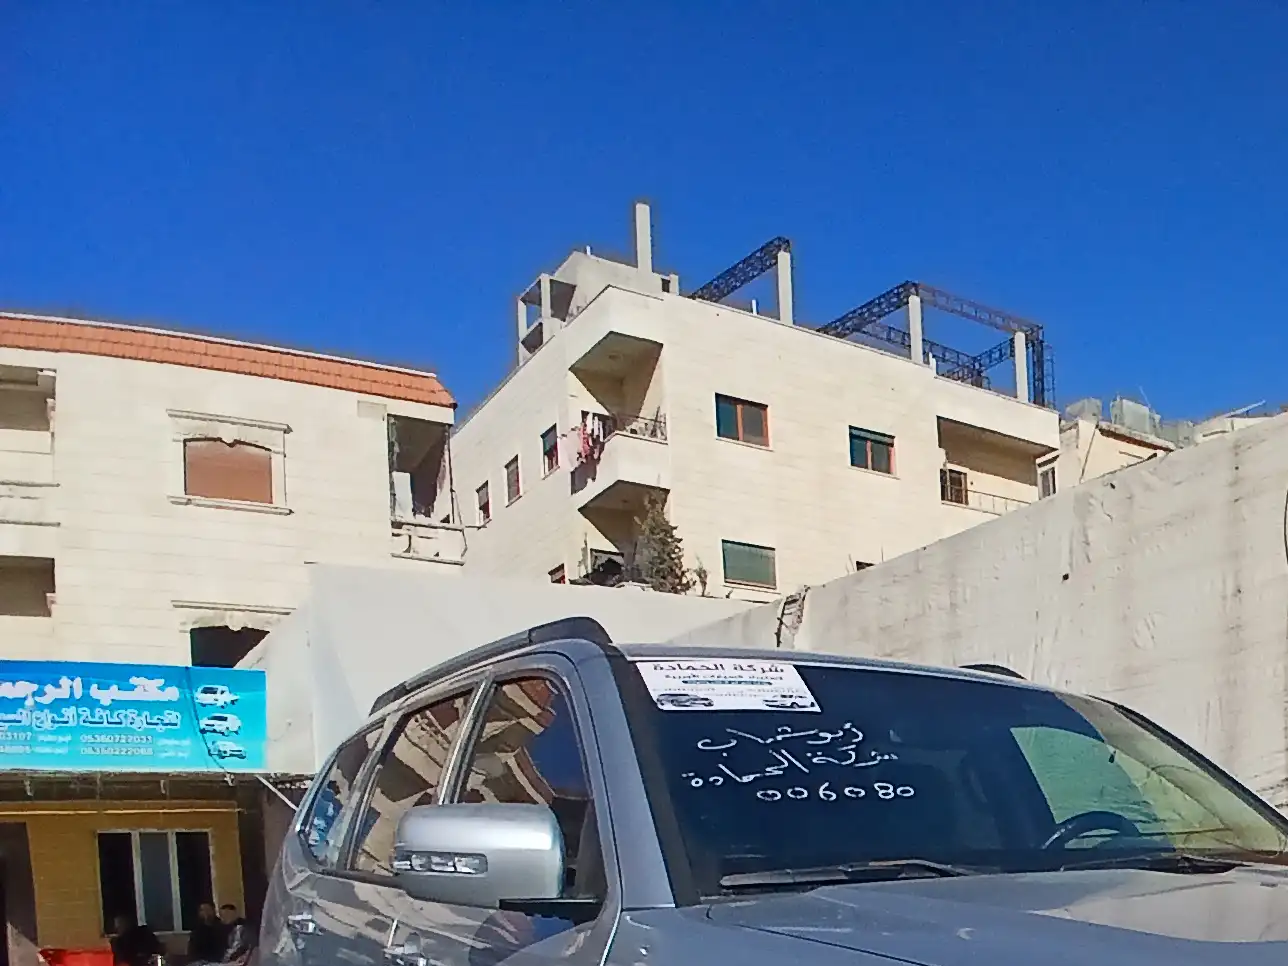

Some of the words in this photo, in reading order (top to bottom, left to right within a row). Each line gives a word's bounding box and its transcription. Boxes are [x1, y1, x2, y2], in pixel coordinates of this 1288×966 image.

[652, 662, 726, 672] الحمادة
[732, 663, 785, 675] شركة
[90, 676, 180, 706] مكتب
[79, 707, 127, 728] كافة
